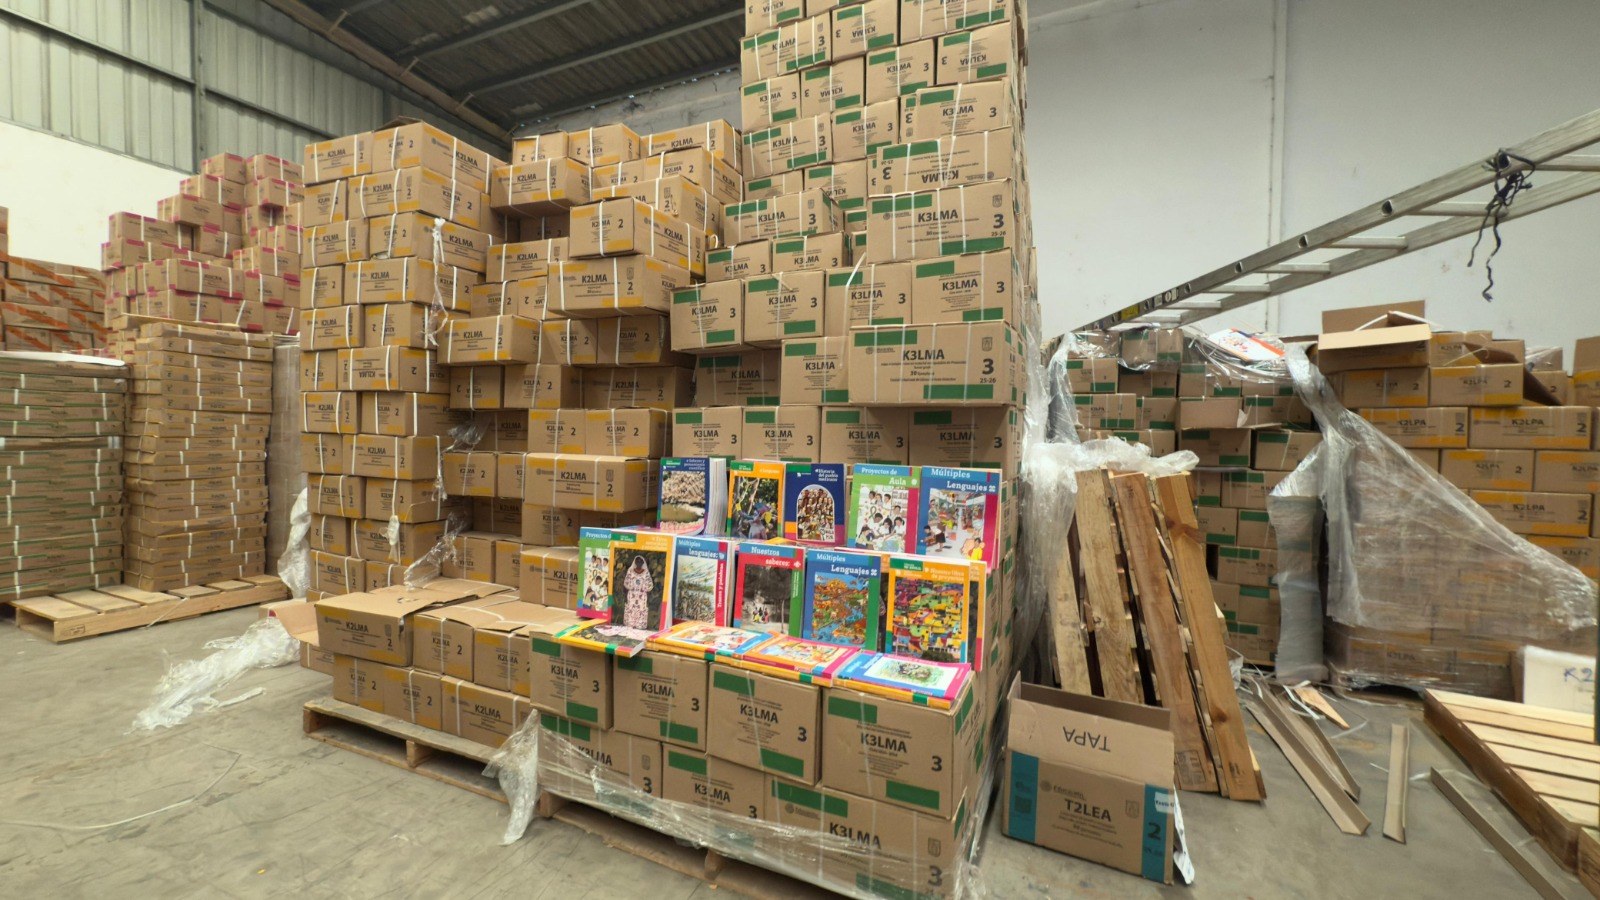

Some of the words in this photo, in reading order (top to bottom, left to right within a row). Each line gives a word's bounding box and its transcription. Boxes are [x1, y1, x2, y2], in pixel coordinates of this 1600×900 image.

[747, 5, 754, 14] 3
[835, 29, 842, 39] 3
[818, 35, 826, 47] 3
[922, 62, 930, 72] 3
[941, 56, 948, 66] 3
[791, 91, 798, 100] 3
[804, 89, 810, 99] 3
[988, 106, 997, 118] 3
[905, 112, 914, 125] 3
[887, 122, 894, 132] 3
[671, 138, 694, 149] K2LMA
[818, 135, 827, 147] 3
[687, 165, 694, 174] 2
[882, 166, 892, 182] 3
[516, 173, 537, 184] K2LMA
[551, 178, 557, 187] 2
[632, 175, 640, 184] 2
[871, 177, 877, 187] 3
[662, 200, 670, 209] 2
[758, 210, 786, 224] K3LMA
[808, 212, 817, 226] 3
[917, 209, 959, 224] K3LMA
[992, 213, 1004, 229] 3
[617, 218, 625, 230] 2
[663, 226, 684, 243] K2LMA
[516, 252, 538, 264] K2LMA
[831, 257, 839, 267] 3
[760, 263, 767, 274] 3
[581, 274, 608, 286] K2LMA
[627, 280, 634, 292] 2
[941, 278, 979, 292] K3LMA
[995, 280, 1005, 294] 3
[850, 289, 883, 302] K3LMA
[898, 292, 906, 305] 3
[810, 297, 818, 309] 3
[729, 307, 737, 319] 3
[583, 336, 590, 346] 2
[901, 348, 945, 362] K3LMA
[805, 361, 836, 372] K3LMA
[981, 357, 994, 376] 3
[546, 381, 553, 391] 2
[979, 376, 997, 385] 25-26
[1412, 382, 1420, 391] 2
[1503, 379, 1512, 389] 2
[1550, 385, 1557, 394] 2
[1455, 421, 1465, 433] 2
[1511, 418, 1545, 428] K2LPA
[1577, 422, 1588, 434] 2
[570, 427, 577, 437] 2
[632, 427, 639, 438] 2
[693, 430, 719, 439] K3LMA
[848, 430, 881, 441] K3LMA
[939, 431, 976, 443] K3LMA
[730, 434, 737, 445] 3
[806, 434, 814, 447] 3
[895, 435, 904, 449] 3
[993, 436, 1003, 450] 3
[480, 469, 486, 480] 2
[861, 467, 888, 476] Proyectos
[930, 467, 971, 480] Múltiples
[1515, 466, 1522, 475] 2
[560, 471, 587, 484] K2LMA
[888, 476, 907, 486] Aula
[606, 483, 613, 495] 2
[946, 481, 988, 495] Lenguajes
[1577, 509, 1588, 521] 2
[750, 546, 781, 557] Nuestros
[815, 553, 847, 565] Múltiples
[830, 564, 870, 578] Lenguajes
[345, 621, 370, 635] K2LMA
[456, 644, 463, 656] 2
[550, 663, 579, 681] K3LMA
[371, 681, 377, 691] 2
[591, 678, 601, 694] 3
[641, 681, 673, 700] K3LMA
[426, 695, 433, 707] 2
[690, 697, 700, 713] 3
[474, 703, 502, 721] K2LMA
[739, 703, 779, 725] K3LMA
[796, 725, 808, 744] 3
[1062, 725, 1112, 753] TAPA
[860, 731, 908, 755] K3LMA
[930, 754, 943, 773] 3
[642, 777, 653, 795] 3
[747, 805, 758, 821] 3
[1064, 798, 1113, 822] T2LEA
[1147, 820, 1162, 842] 2
[926, 865, 943, 888] 3
